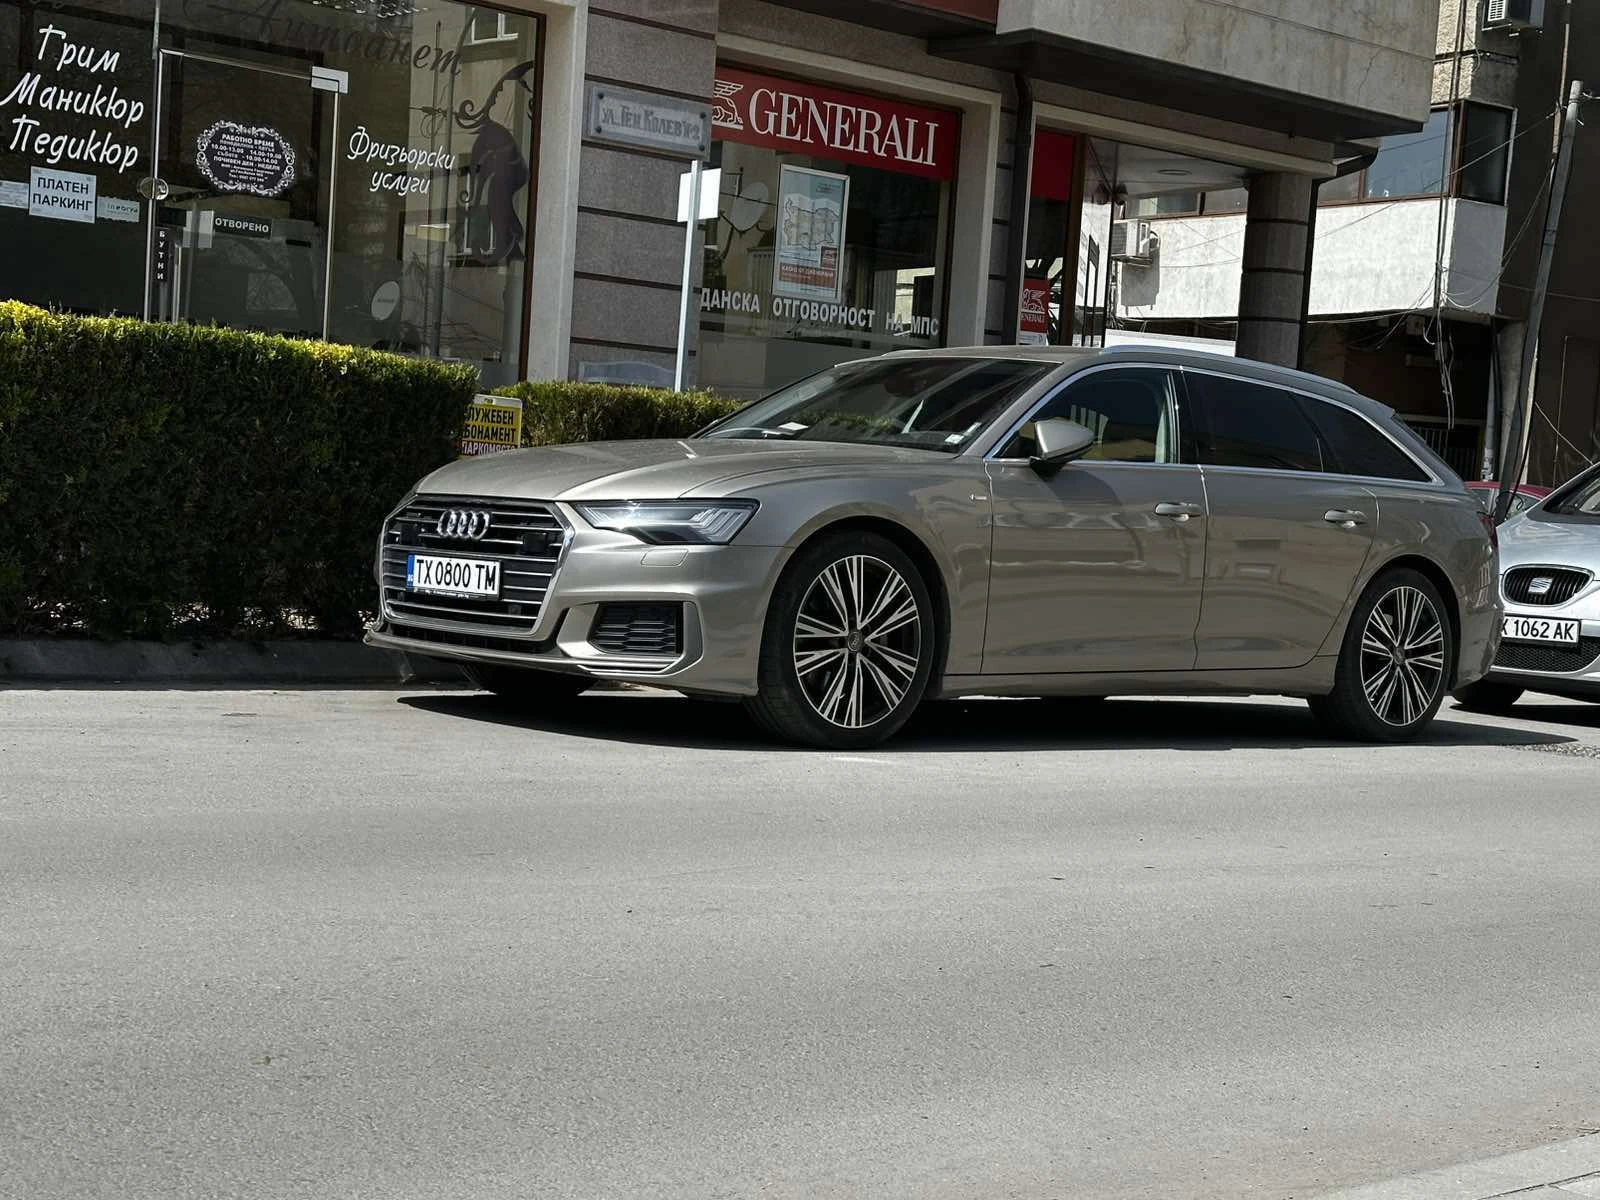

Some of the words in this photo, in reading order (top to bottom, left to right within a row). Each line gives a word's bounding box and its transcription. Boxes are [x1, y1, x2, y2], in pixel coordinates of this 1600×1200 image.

[38, 24, 120, 72] Грим
[0, 72, 144, 129] Маникюр
[750, 88, 939, 166] GENERALI
[9, 113, 138, 174] Педикюр
[347, 126, 455, 170] Фризьорски
[37, 177, 89, 195] ПЛАТЕН
[369, 171, 431, 196] услуги
[32, 193, 93, 211] ПАРКИНГ
[214, 217, 269, 233] ОТВОРЕНО
[700, 287, 760, 313] ДАНСКА
[773, 297, 876, 328] ОТГОВОРНОСТ
[885, 311, 904, 332] НА
[910, 315, 940, 335] МПС
[463, 424, 516, 442] БОНАМЕНТ
[416, 559, 433, 585] TX
[435, 561, 471, 588] 0800
[475, 564, 497, 591] TM
[1514, 619, 1550, 639] 1062
[1553, 622, 1575, 640] AK
